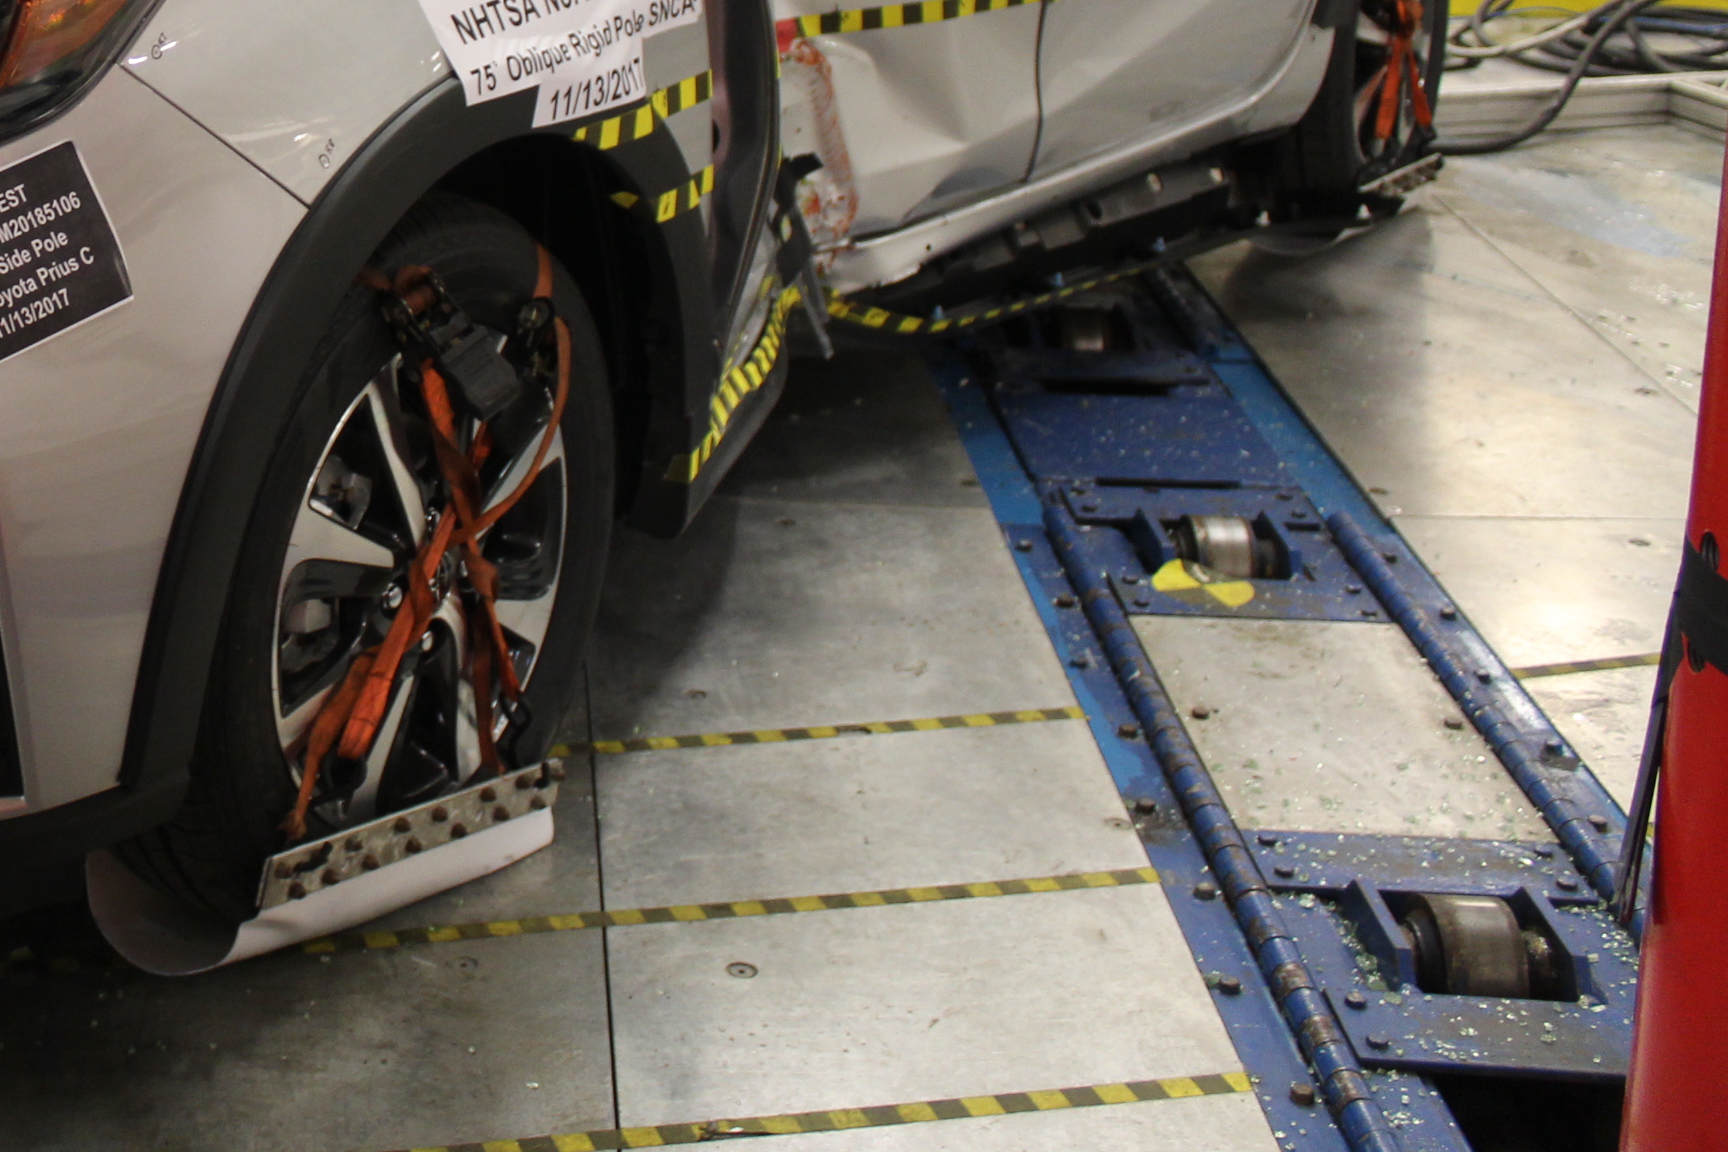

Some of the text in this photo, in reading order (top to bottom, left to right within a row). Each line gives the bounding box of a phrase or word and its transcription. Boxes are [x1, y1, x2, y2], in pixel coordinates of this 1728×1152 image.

[506, 43, 571, 82] Oblique
[568, 21, 613, 59] Rigid
[613, 10, 645, 41] Pole
[550, 57, 643, 121] 11/13/2017
[31, 232, 68, 257] Pole
[36, 258, 79, 285] Prius
[80, 247, 94, 264] C
